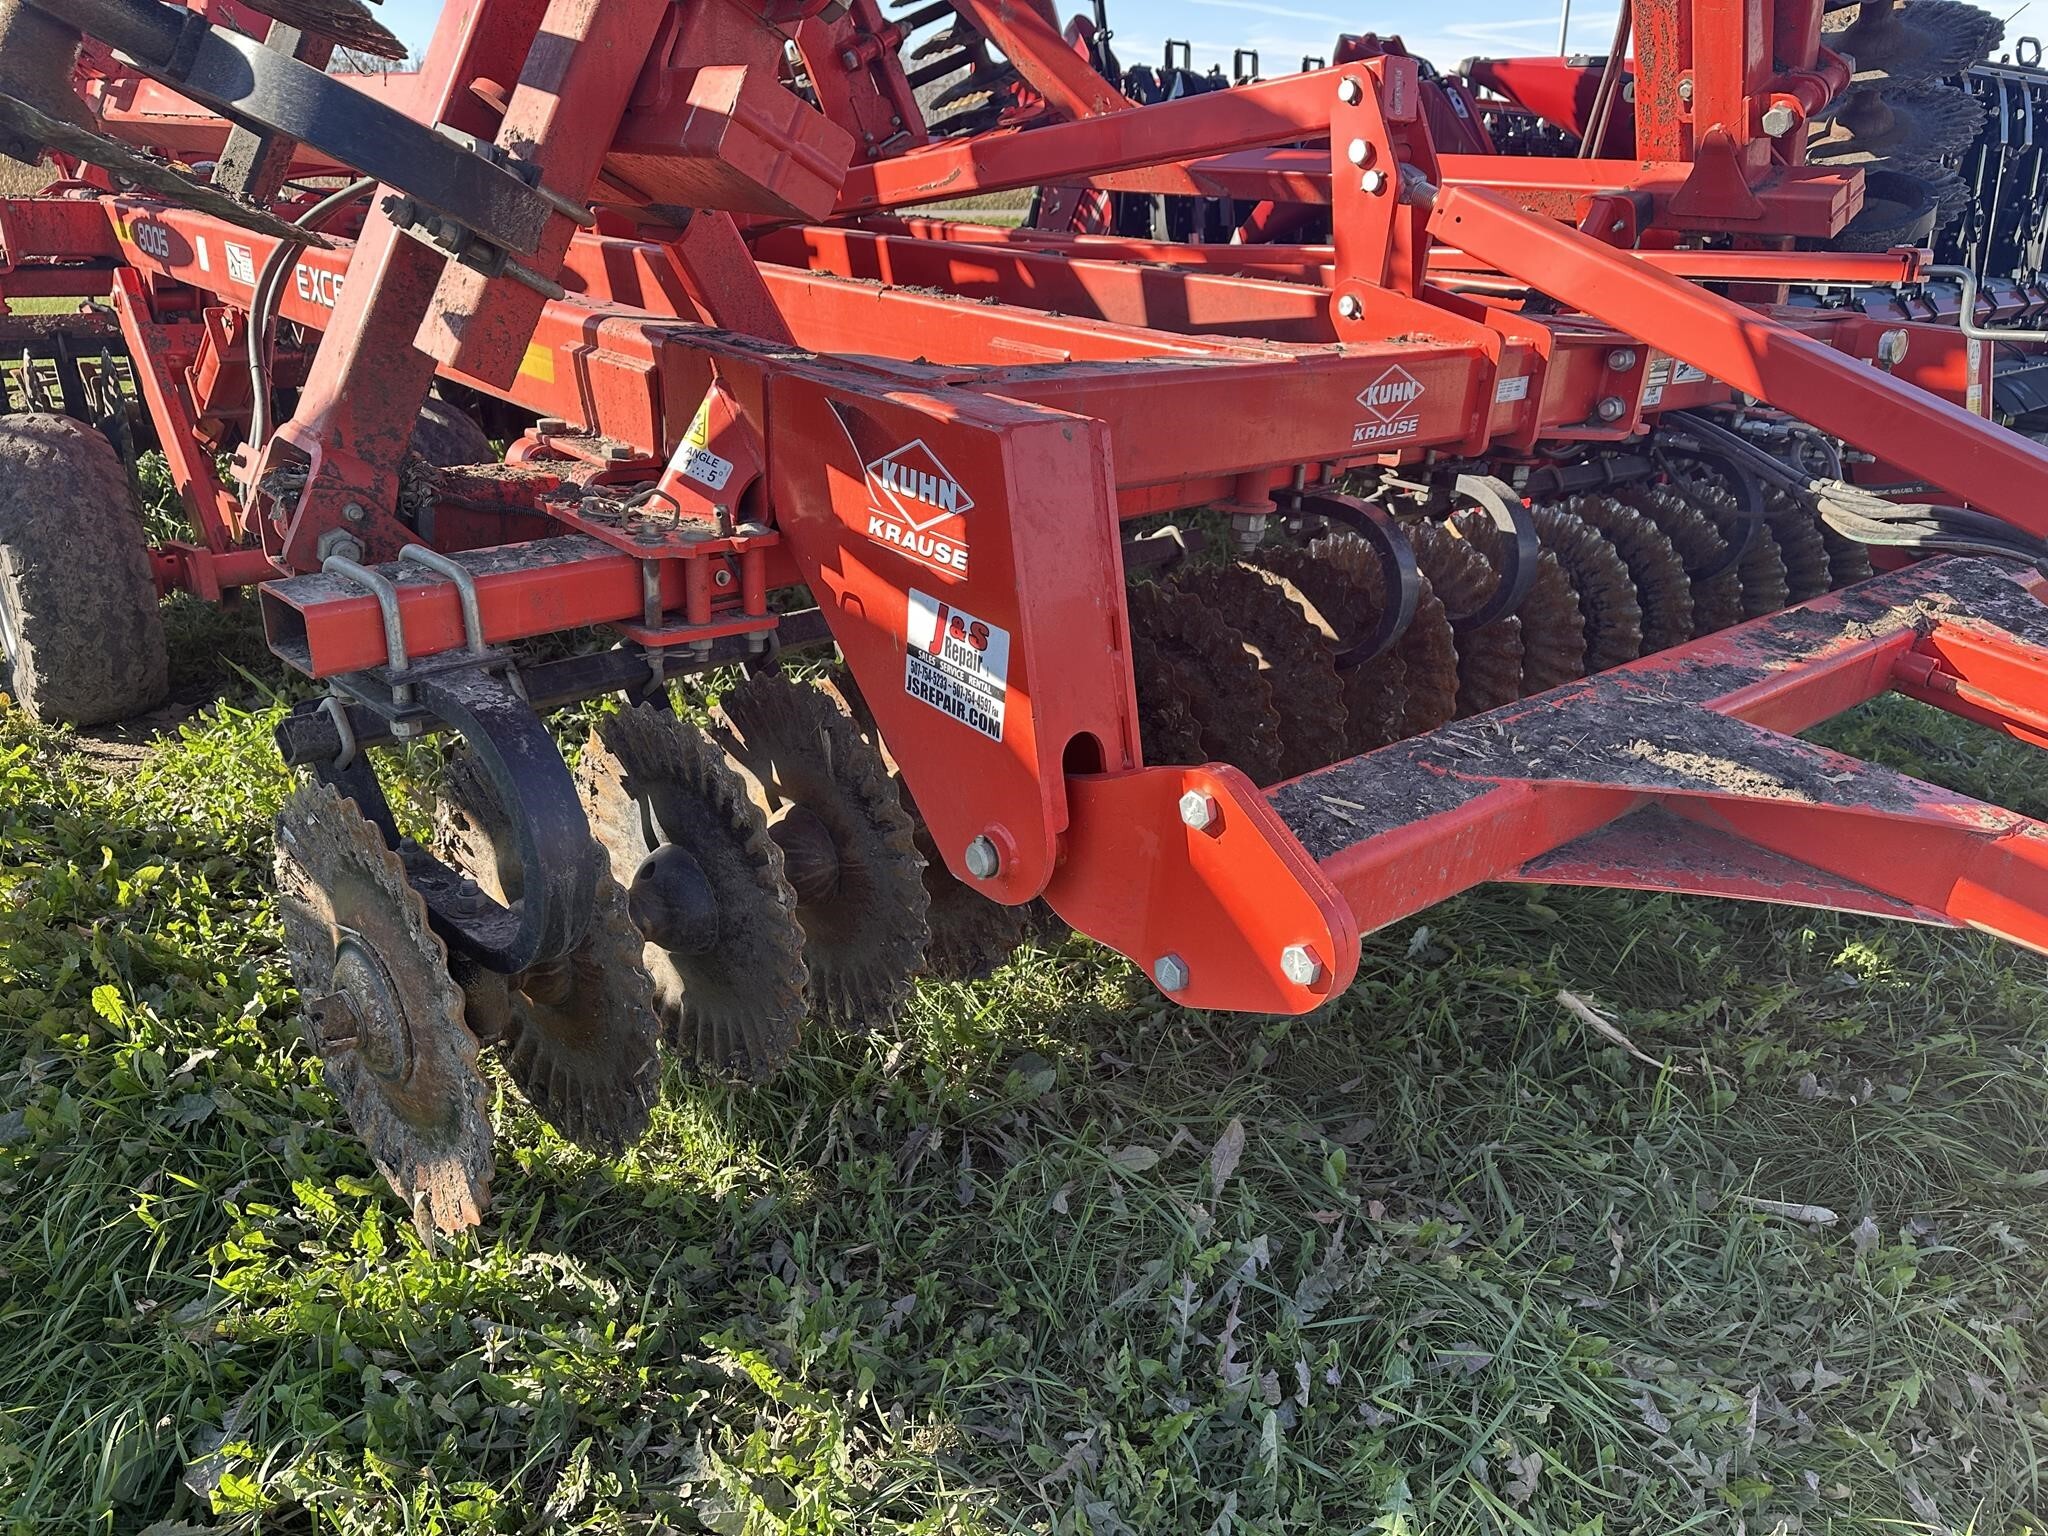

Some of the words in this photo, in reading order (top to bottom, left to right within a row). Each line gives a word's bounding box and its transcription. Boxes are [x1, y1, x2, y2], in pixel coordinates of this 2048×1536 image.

[138, 223, 168, 257] 8005
[1366, 381, 1417, 407] KUHN
[1353, 419, 1418, 441] KRAUSE
[685, 446, 720, 469] ANGLE
[882, 459, 957, 514] KUHN
[868, 516, 969, 571] KRAUSE
[918, 650, 936, 667] SALES
[940, 661, 965, 681] SERVICE
[968, 676, 993, 695] RENTAL
[944, 635, 984, 674] Repair
[906, 674, 1001, 739] JSREPAIR.COM
